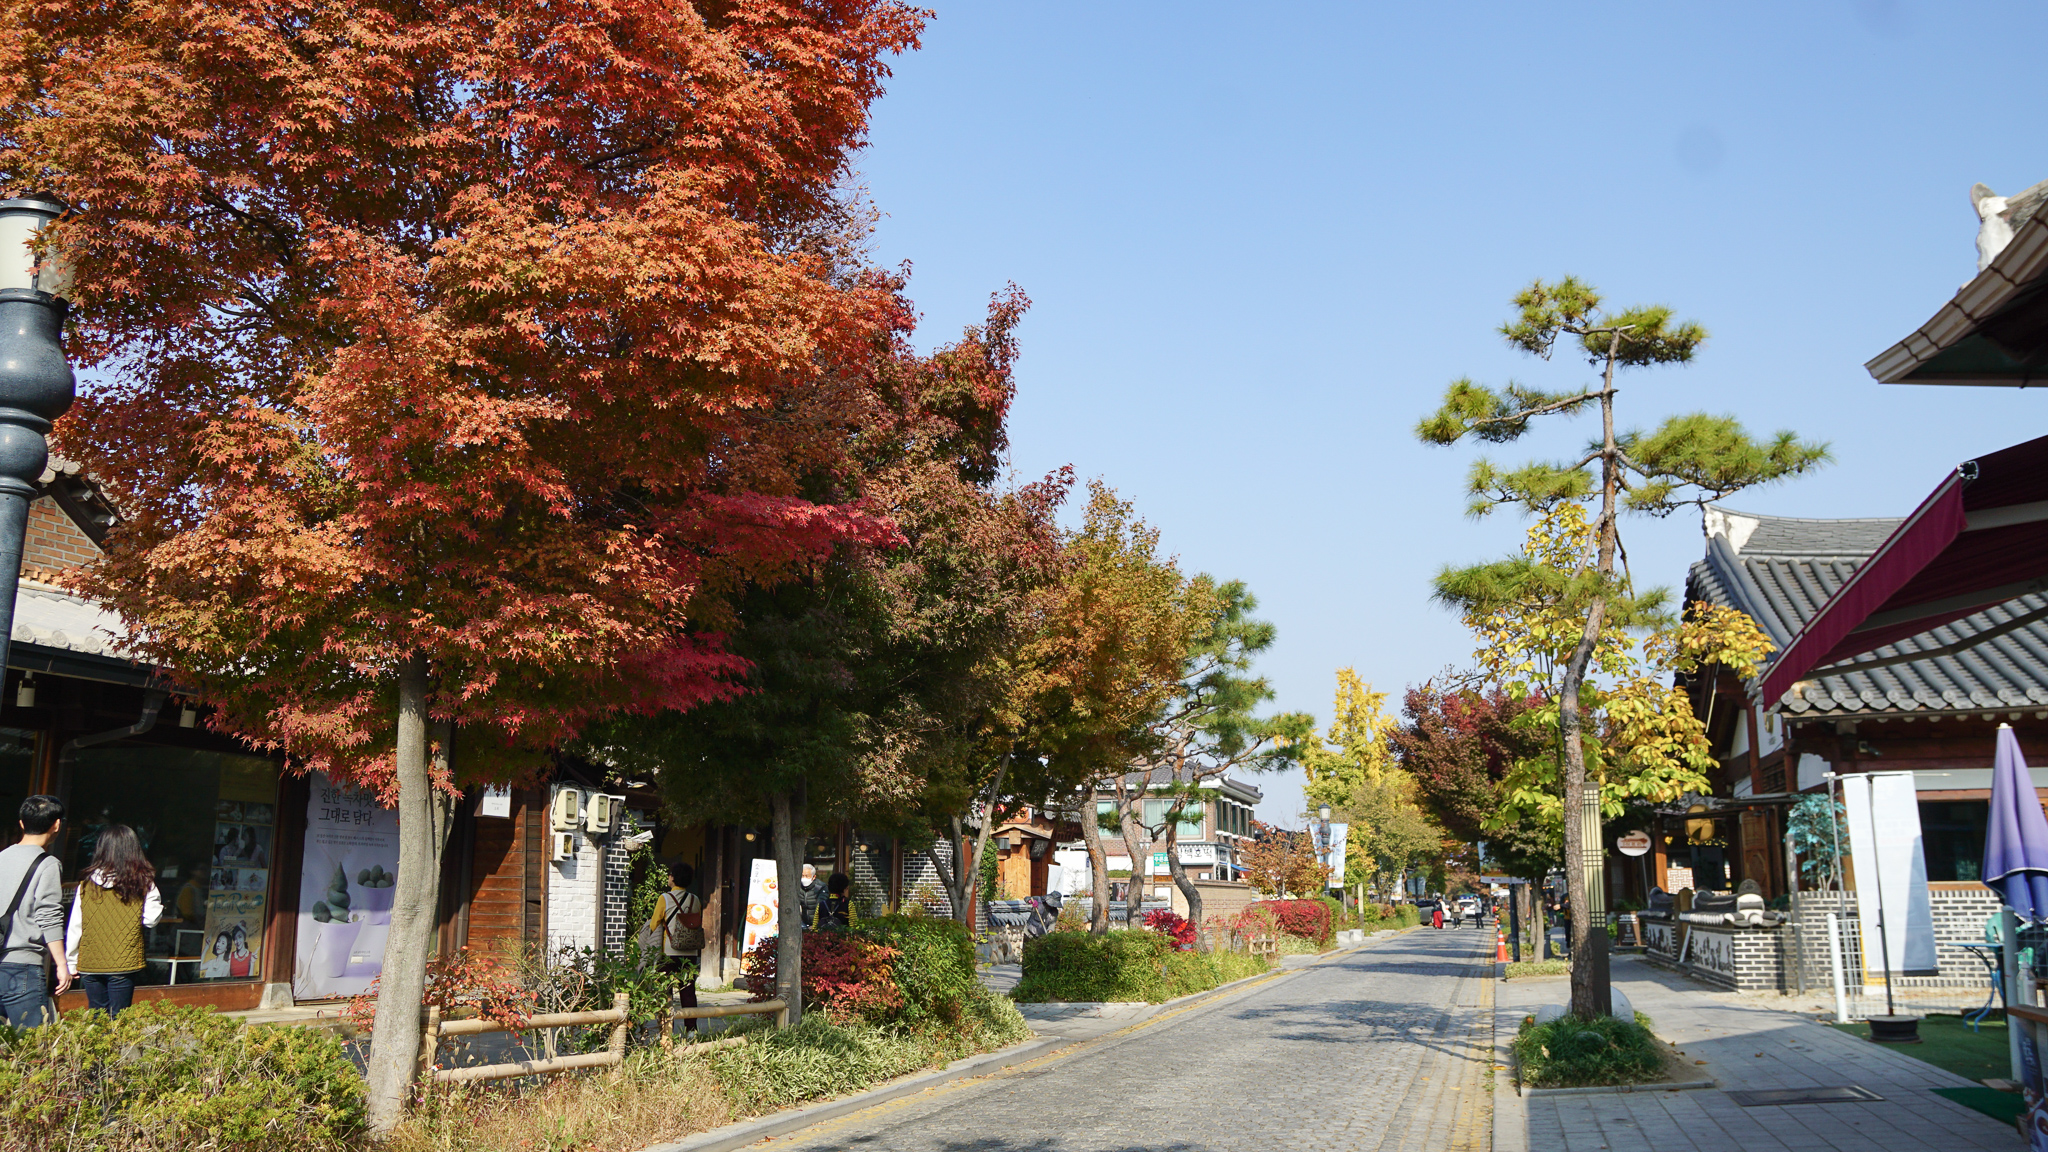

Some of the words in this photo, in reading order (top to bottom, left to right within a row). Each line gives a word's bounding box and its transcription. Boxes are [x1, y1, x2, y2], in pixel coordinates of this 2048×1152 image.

[320, 787, 341, 804] 진한
[318, 807, 351, 823] 그대로
[353, 810, 375, 826] 담다.
